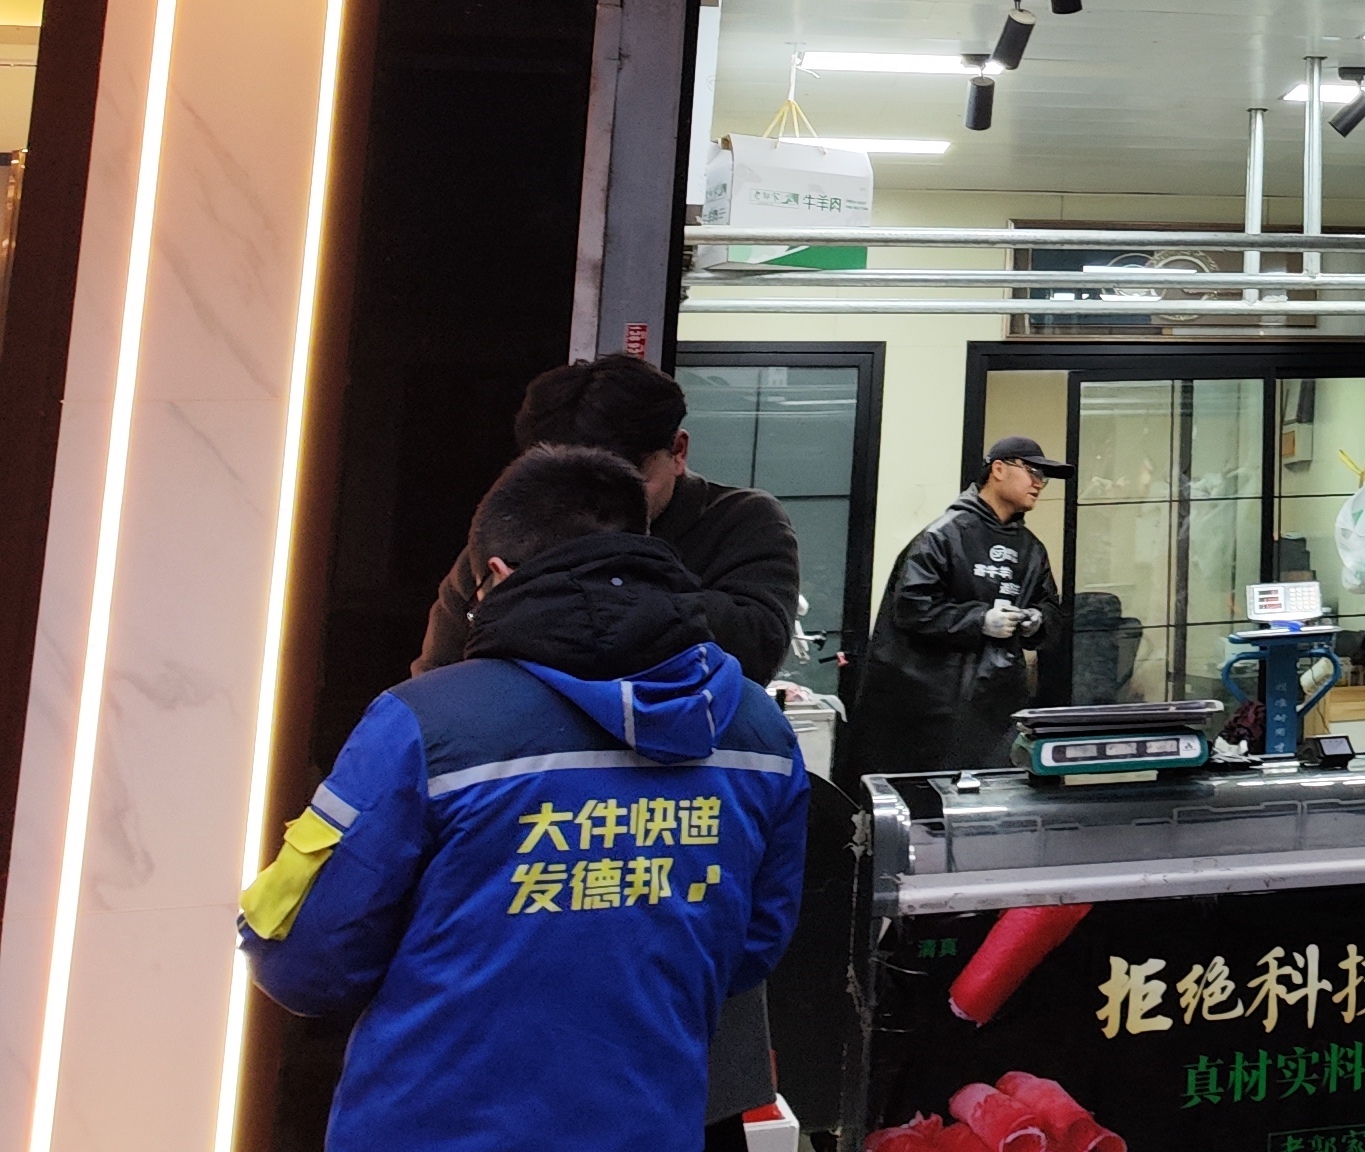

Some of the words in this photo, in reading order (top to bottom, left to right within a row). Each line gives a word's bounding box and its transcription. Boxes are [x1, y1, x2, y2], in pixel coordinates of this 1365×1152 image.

[516, 796, 722, 853] 大件快递
[506, 856, 675, 915] 发德邦
[917, 938, 958, 959] 清真
